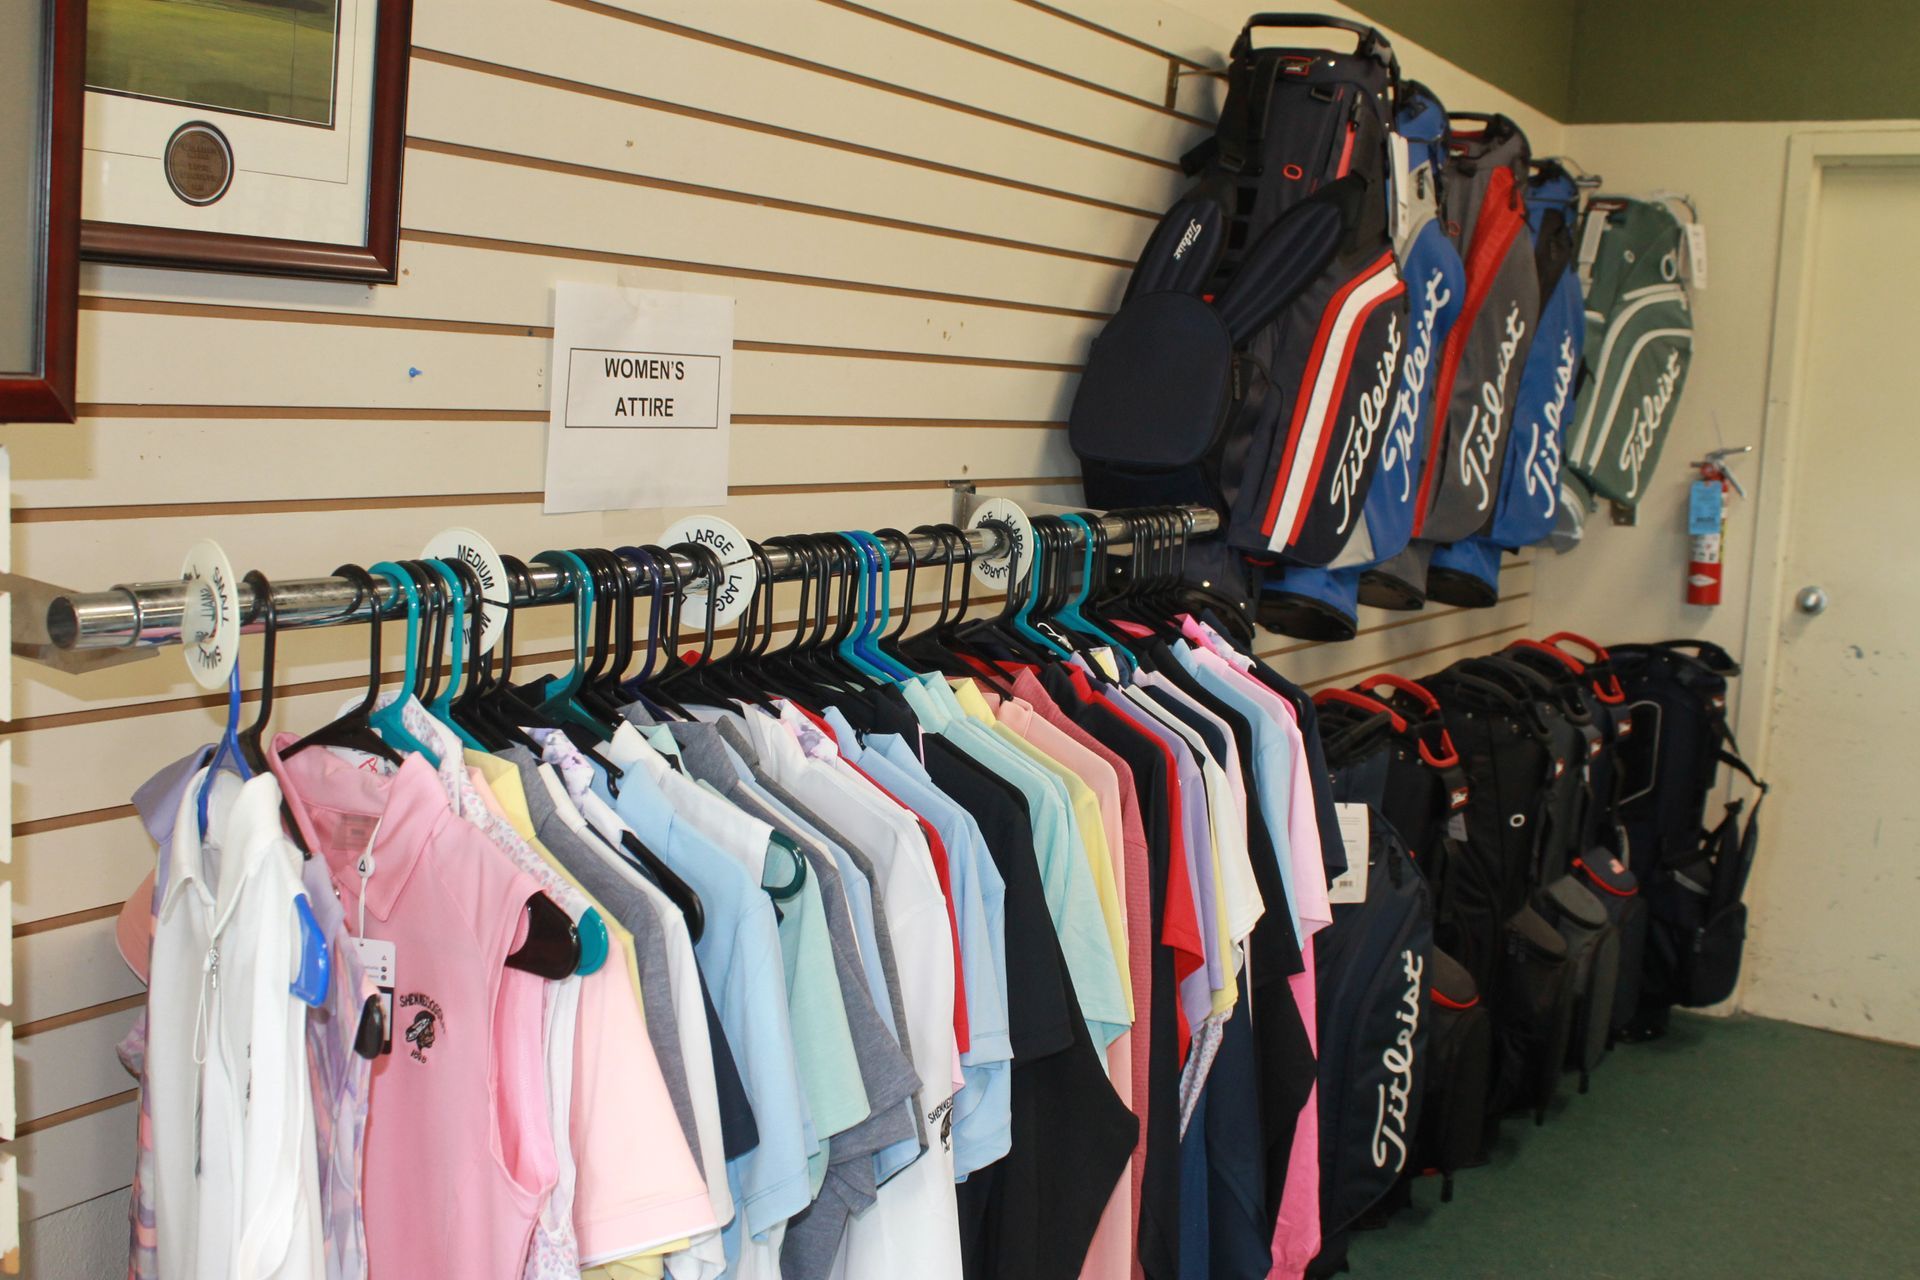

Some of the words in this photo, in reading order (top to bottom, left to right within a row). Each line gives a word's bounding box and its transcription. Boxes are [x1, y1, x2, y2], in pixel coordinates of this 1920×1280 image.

[604, 357, 685, 380] WOMEN'S
[614, 396, 674, 417] ATTIRE
[1381, 271, 1451, 503] Titleist
[1458, 307, 1525, 511] Titleist
[1330, 315, 1401, 535] Titleist
[1618, 350, 1681, 499] Titleist
[457, 544, 495, 590] MEDIUM
[685, 529, 735, 556] LARGE
[705, 575, 743, 612] LARG
[1372, 949, 1423, 1174] Titleist
